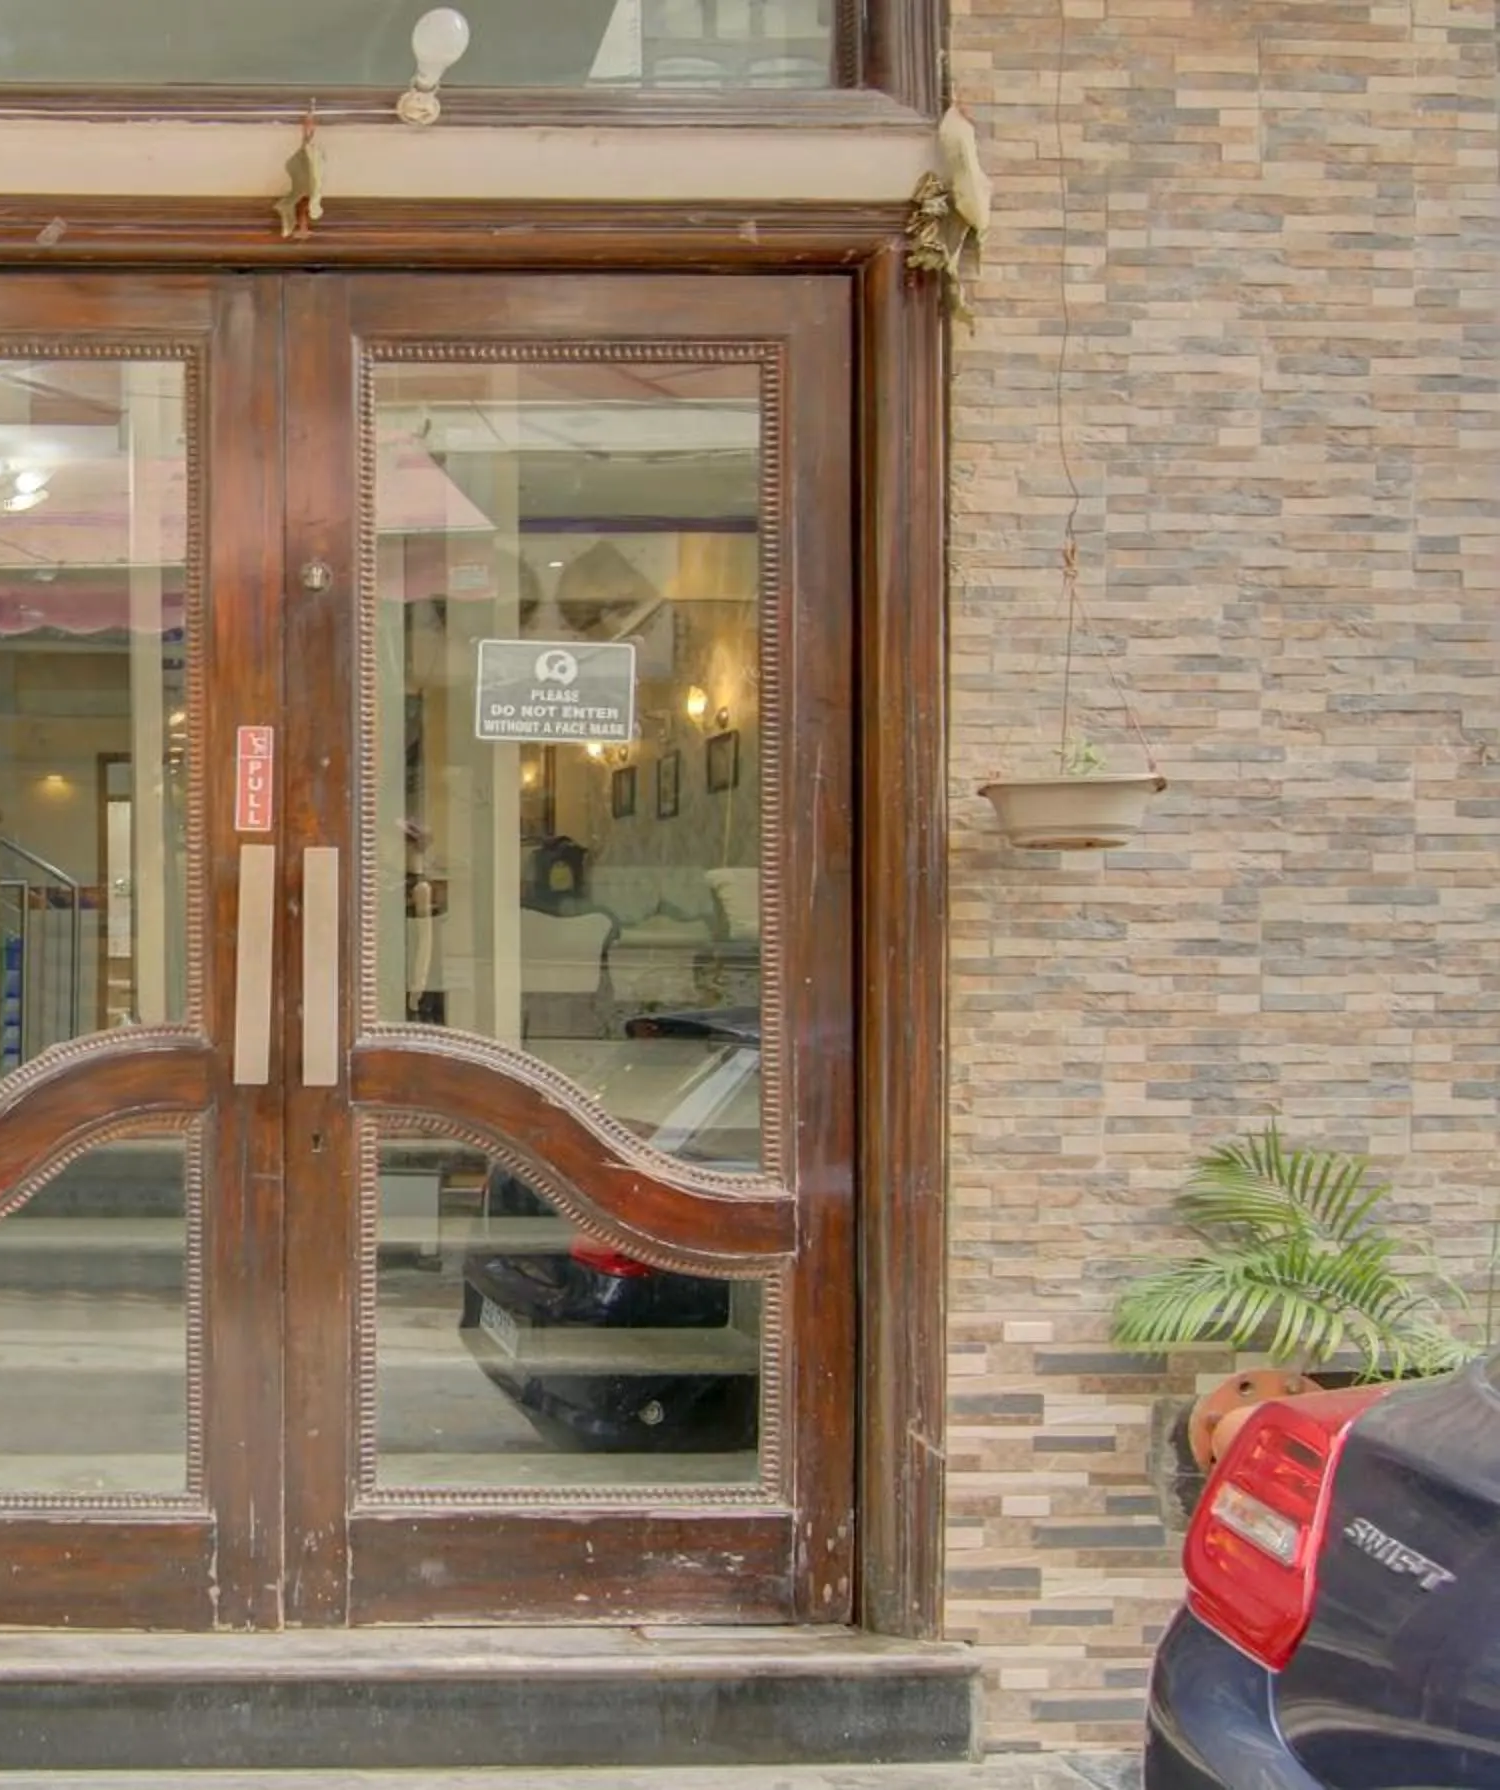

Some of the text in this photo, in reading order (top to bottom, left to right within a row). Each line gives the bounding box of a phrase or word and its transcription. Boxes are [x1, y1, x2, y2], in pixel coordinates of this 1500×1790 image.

[531, 689, 579, 702] PLEASE
[490, 704, 619, 720] DO NOT ENTER
[483, 719, 625, 736] WITHOUT A FACE MASK
[248, 760, 262, 825] PULL
[1343, 1517, 1457, 1591] SWIFT
